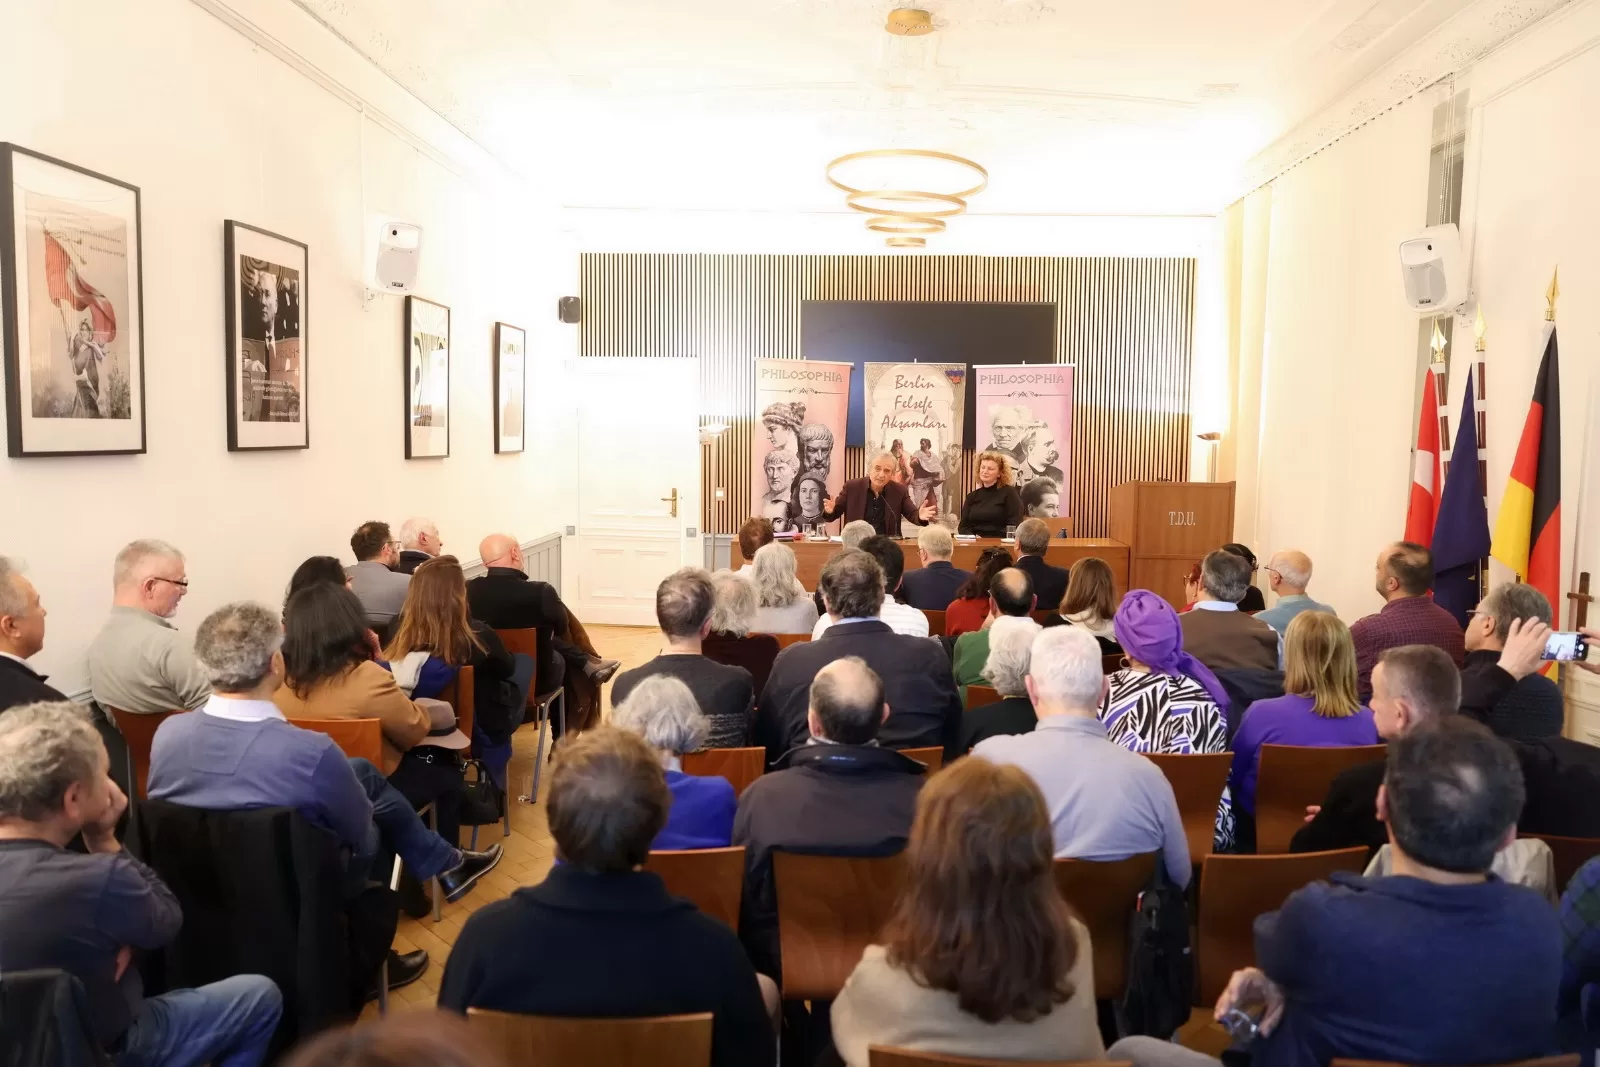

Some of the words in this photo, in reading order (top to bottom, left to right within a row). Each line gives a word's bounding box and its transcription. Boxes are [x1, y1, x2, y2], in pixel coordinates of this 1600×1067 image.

[761, 368, 843, 383] PHILOSOPHIA
[895, 374, 935, 389] Berlin
[979, 373, 1065, 385] PHILOSOPHIA
[894, 395, 933, 414] Felsefe
[881, 414, 948, 432] Akşamları
[1168, 511, 1196, 526] T.D.U.
